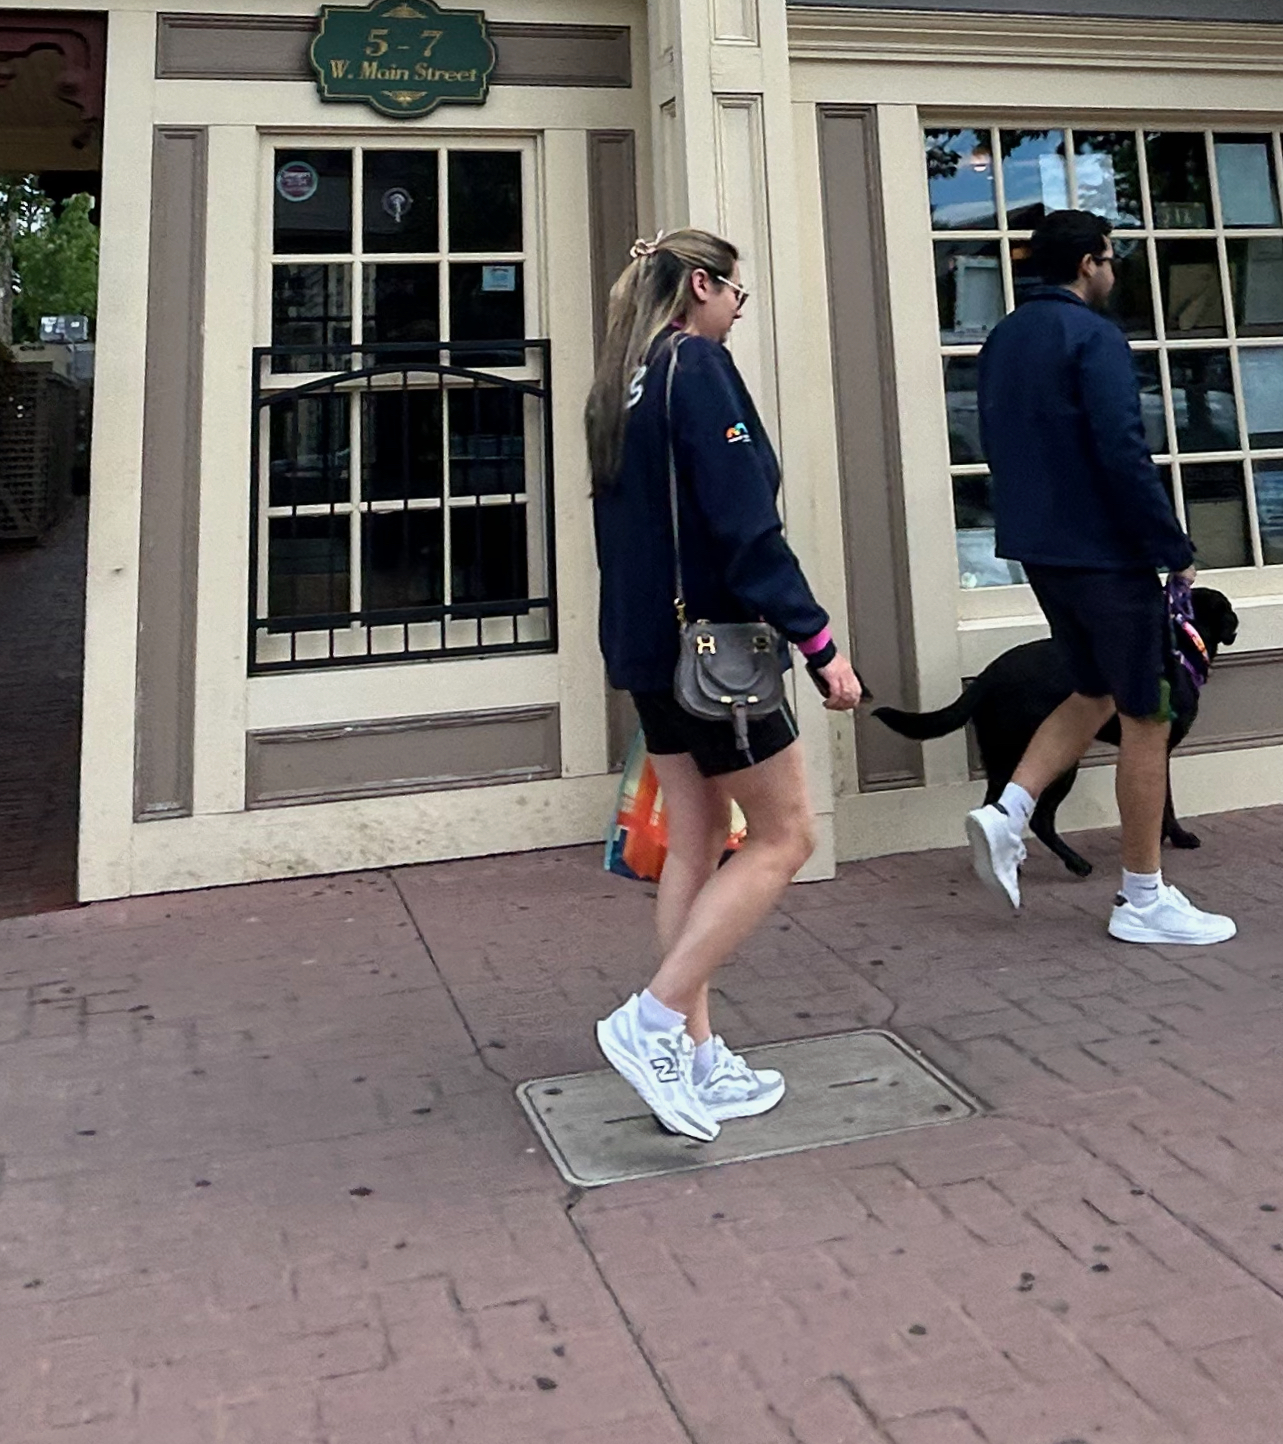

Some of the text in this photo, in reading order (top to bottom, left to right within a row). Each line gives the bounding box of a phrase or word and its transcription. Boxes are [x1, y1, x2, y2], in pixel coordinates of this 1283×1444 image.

[329, 59, 479, 82] W. Main Street
